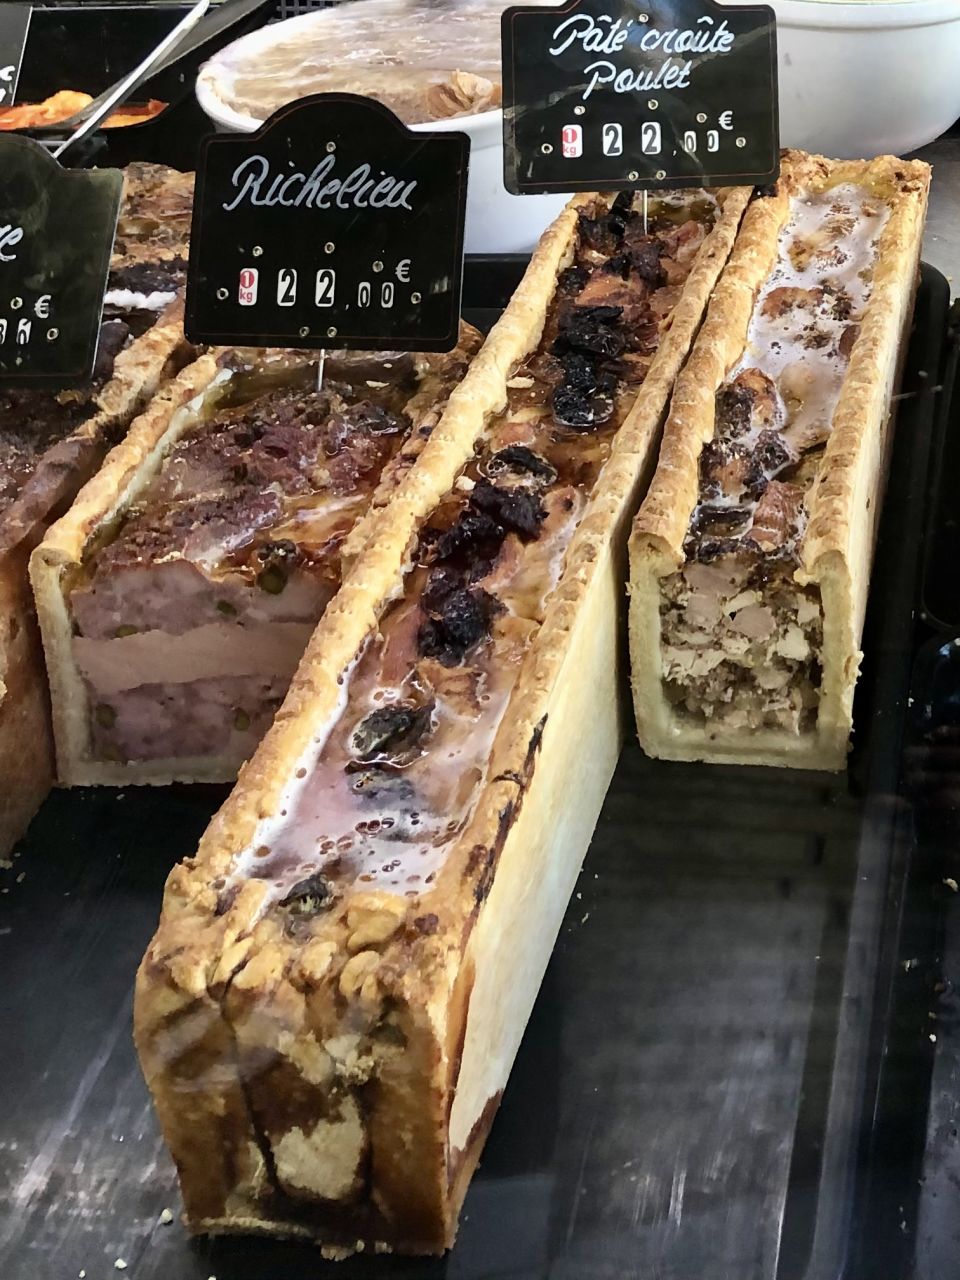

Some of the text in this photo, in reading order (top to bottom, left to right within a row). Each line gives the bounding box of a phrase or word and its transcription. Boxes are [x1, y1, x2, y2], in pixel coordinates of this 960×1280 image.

[548, 13, 736, 56] Pâté croûte
[582, 57, 694, 101] Poulet
[221, 153, 419, 213] Richelieu
